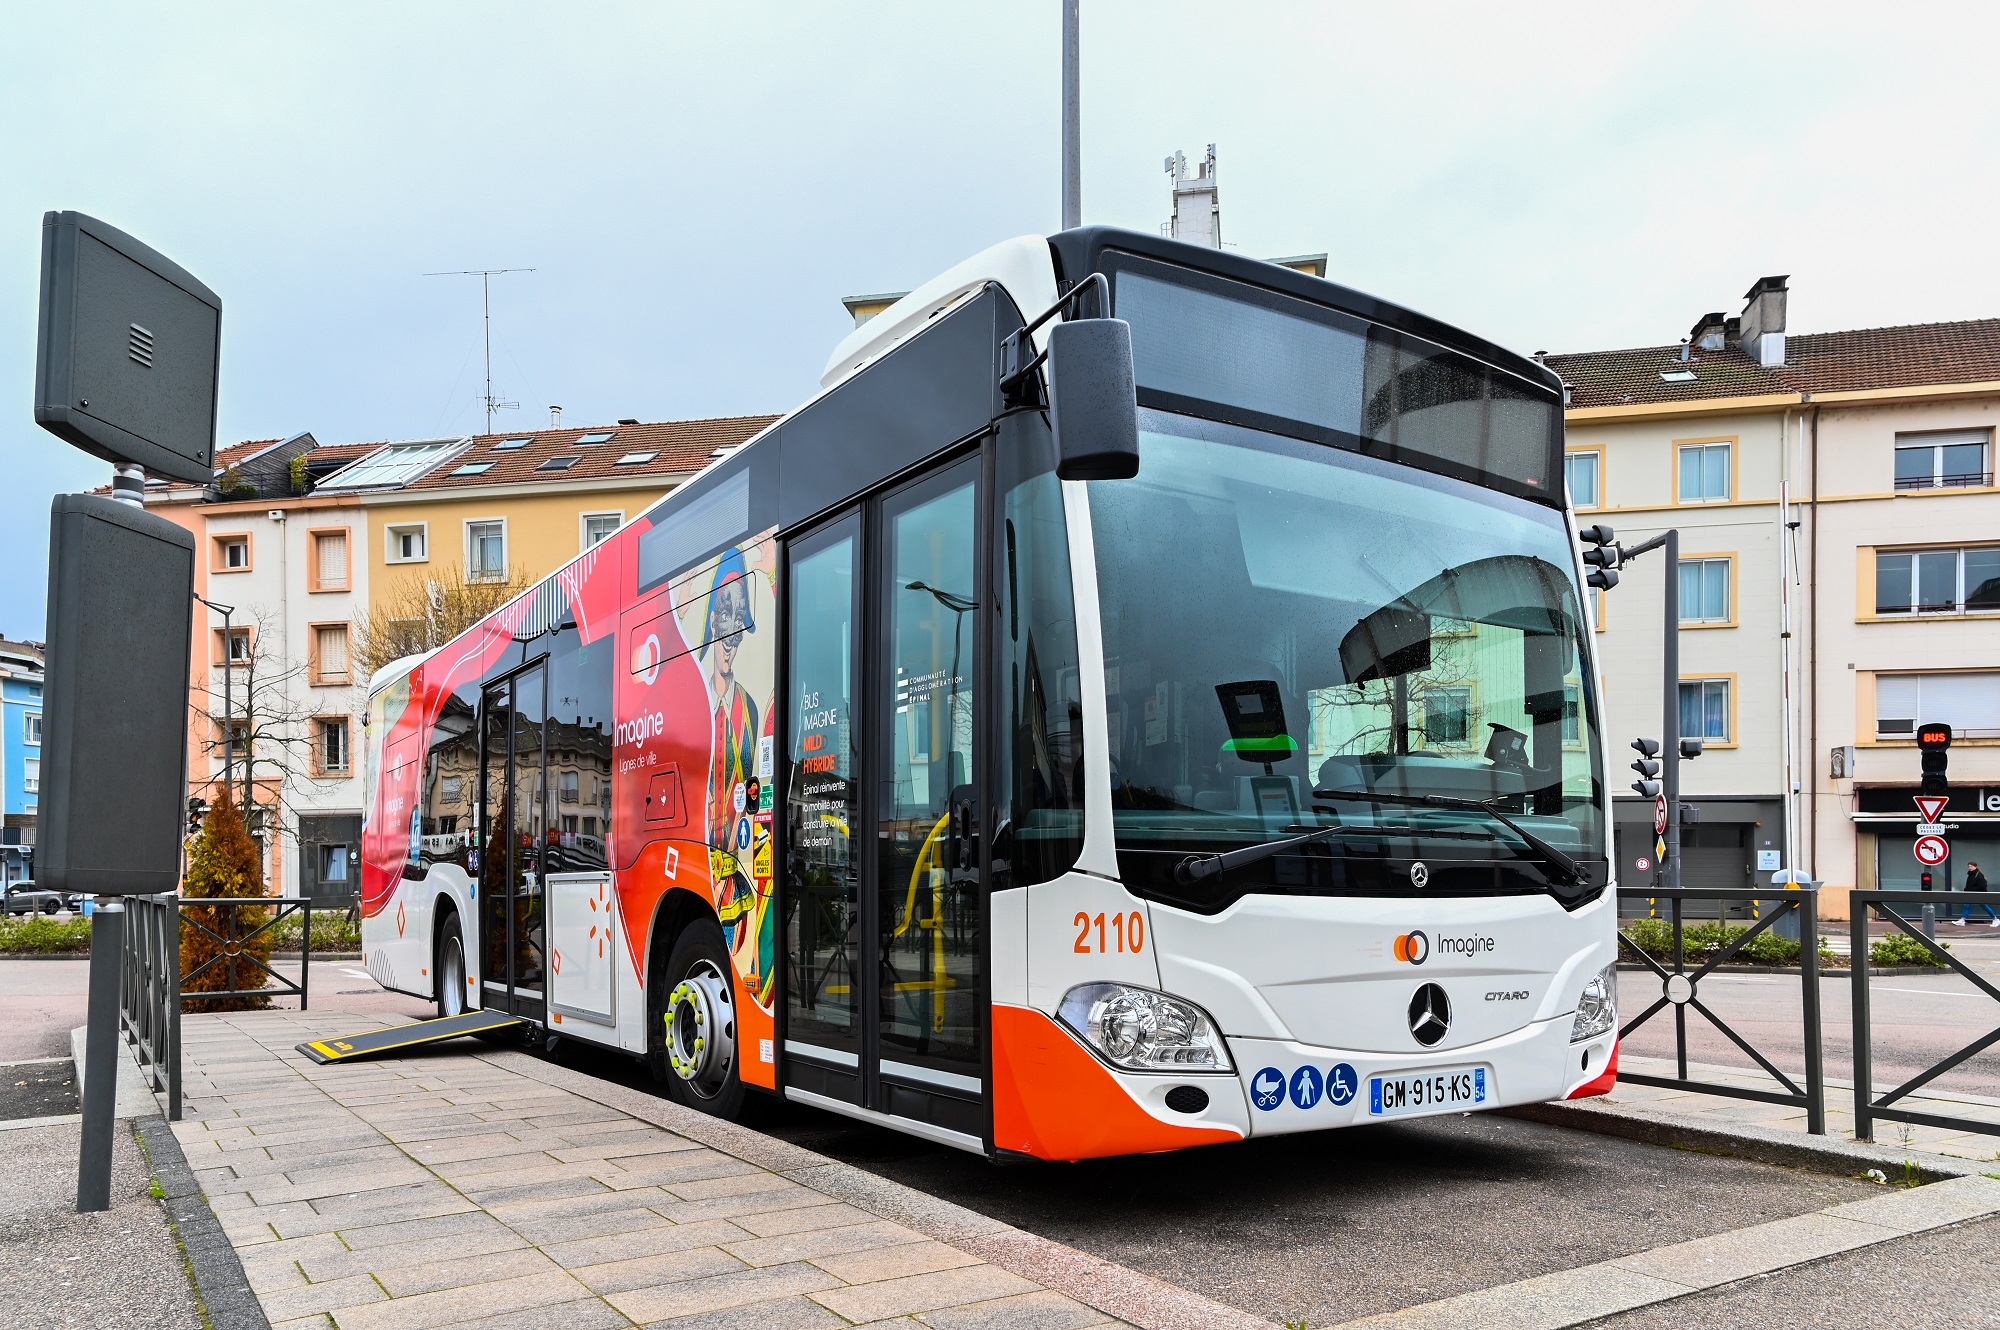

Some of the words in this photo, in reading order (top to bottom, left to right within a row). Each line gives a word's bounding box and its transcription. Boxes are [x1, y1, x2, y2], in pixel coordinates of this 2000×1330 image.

[910, 669, 946, 684] COMMUNAUTÉ
[804, 692, 819, 710] BUS
[614, 708, 664, 749] Imagine
[803, 734, 823, 752] MILD
[1923, 733, 1946, 743] BUS
[637, 754, 645, 768] de
[803, 754, 837, 774] HYBRIDE
[755, 859, 770, 867] ANGLES
[1073, 911, 1144, 954] 2110
[1437, 933, 1495, 958] Imagine
[1484, 991, 1530, 1002] CITARO
[1374, 1099, 1379, 1108] F
[1383, 1074, 1471, 1109] GM-915-KS
[1475, 1086, 1485, 1099] 54
